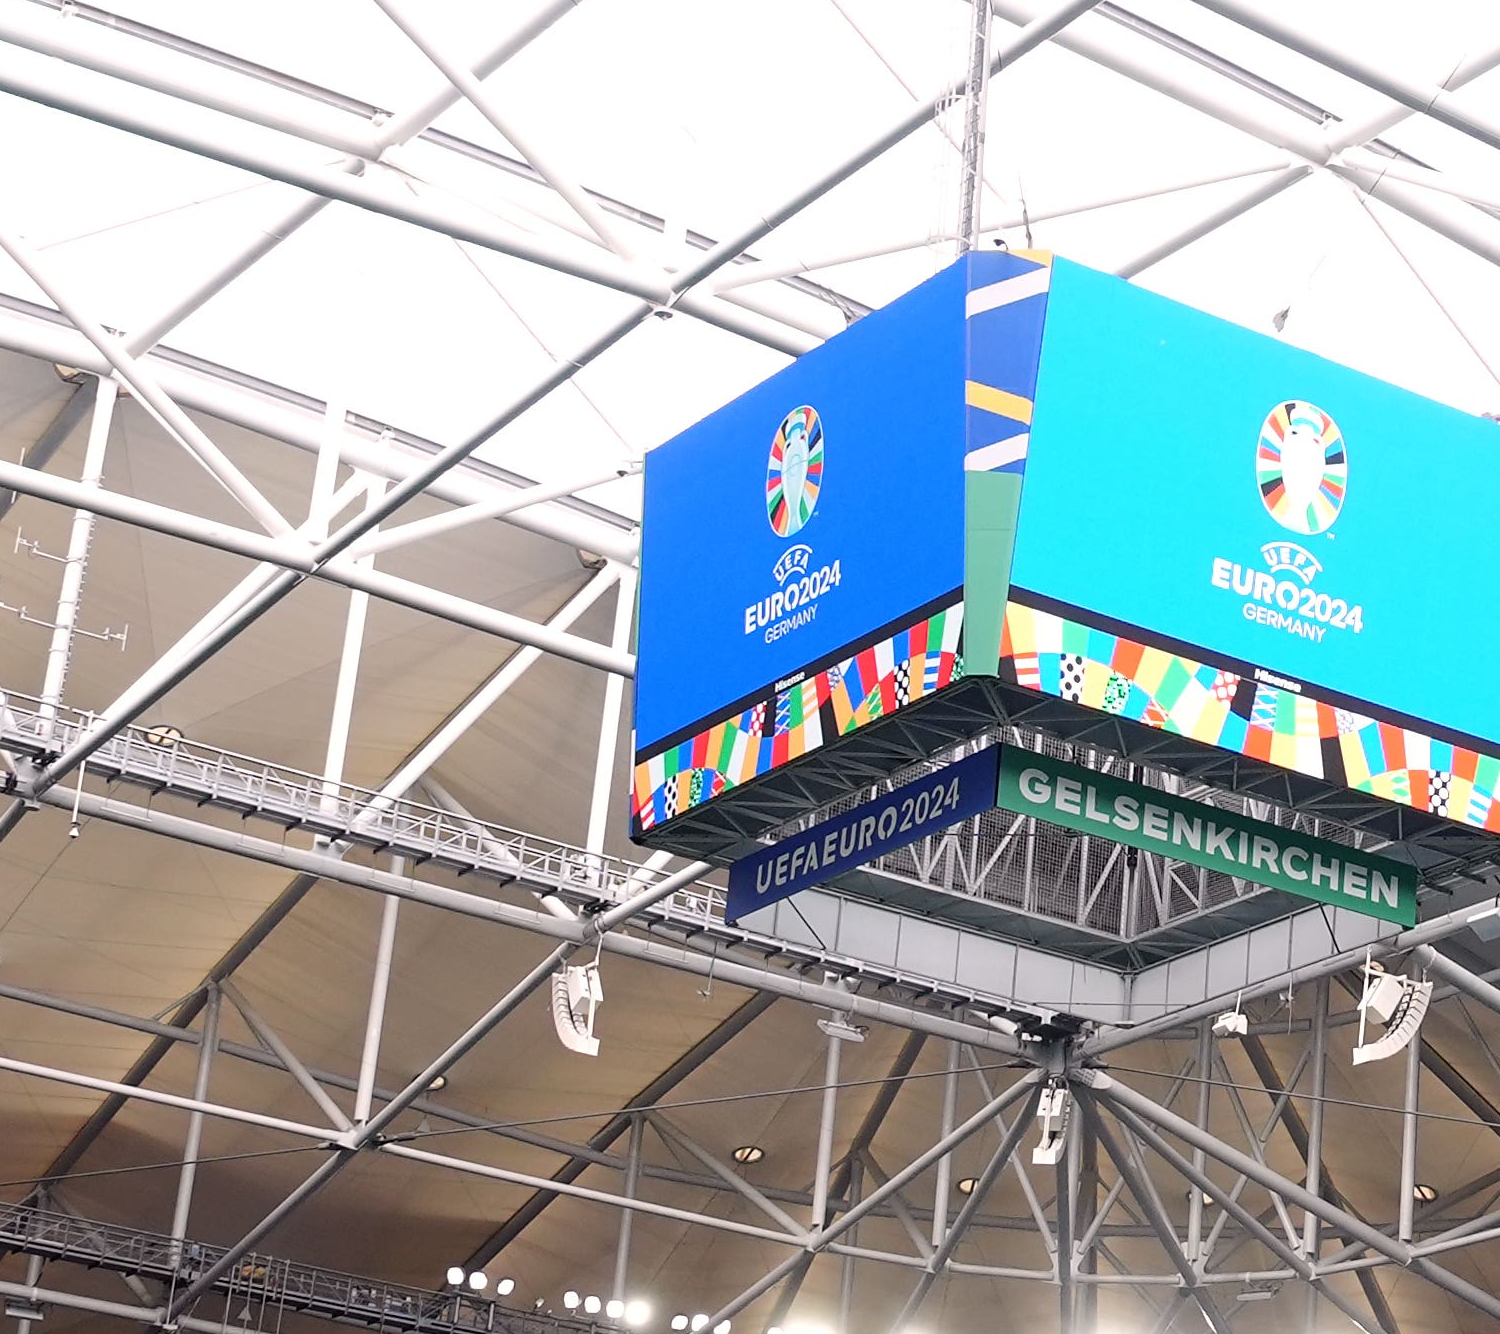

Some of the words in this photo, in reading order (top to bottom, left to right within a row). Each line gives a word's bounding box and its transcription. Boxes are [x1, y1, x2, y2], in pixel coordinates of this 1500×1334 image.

[773, 550, 809, 582] UEFA
[1263, 547, 1317, 582] UEFA
[765, 604, 818, 644] GERMANY
[1242, 603, 1327, 643] GERMANY
[774, 671, 806, 693] Hisense
[1019, 768, 1399, 909] GELSENKIRCHEN
